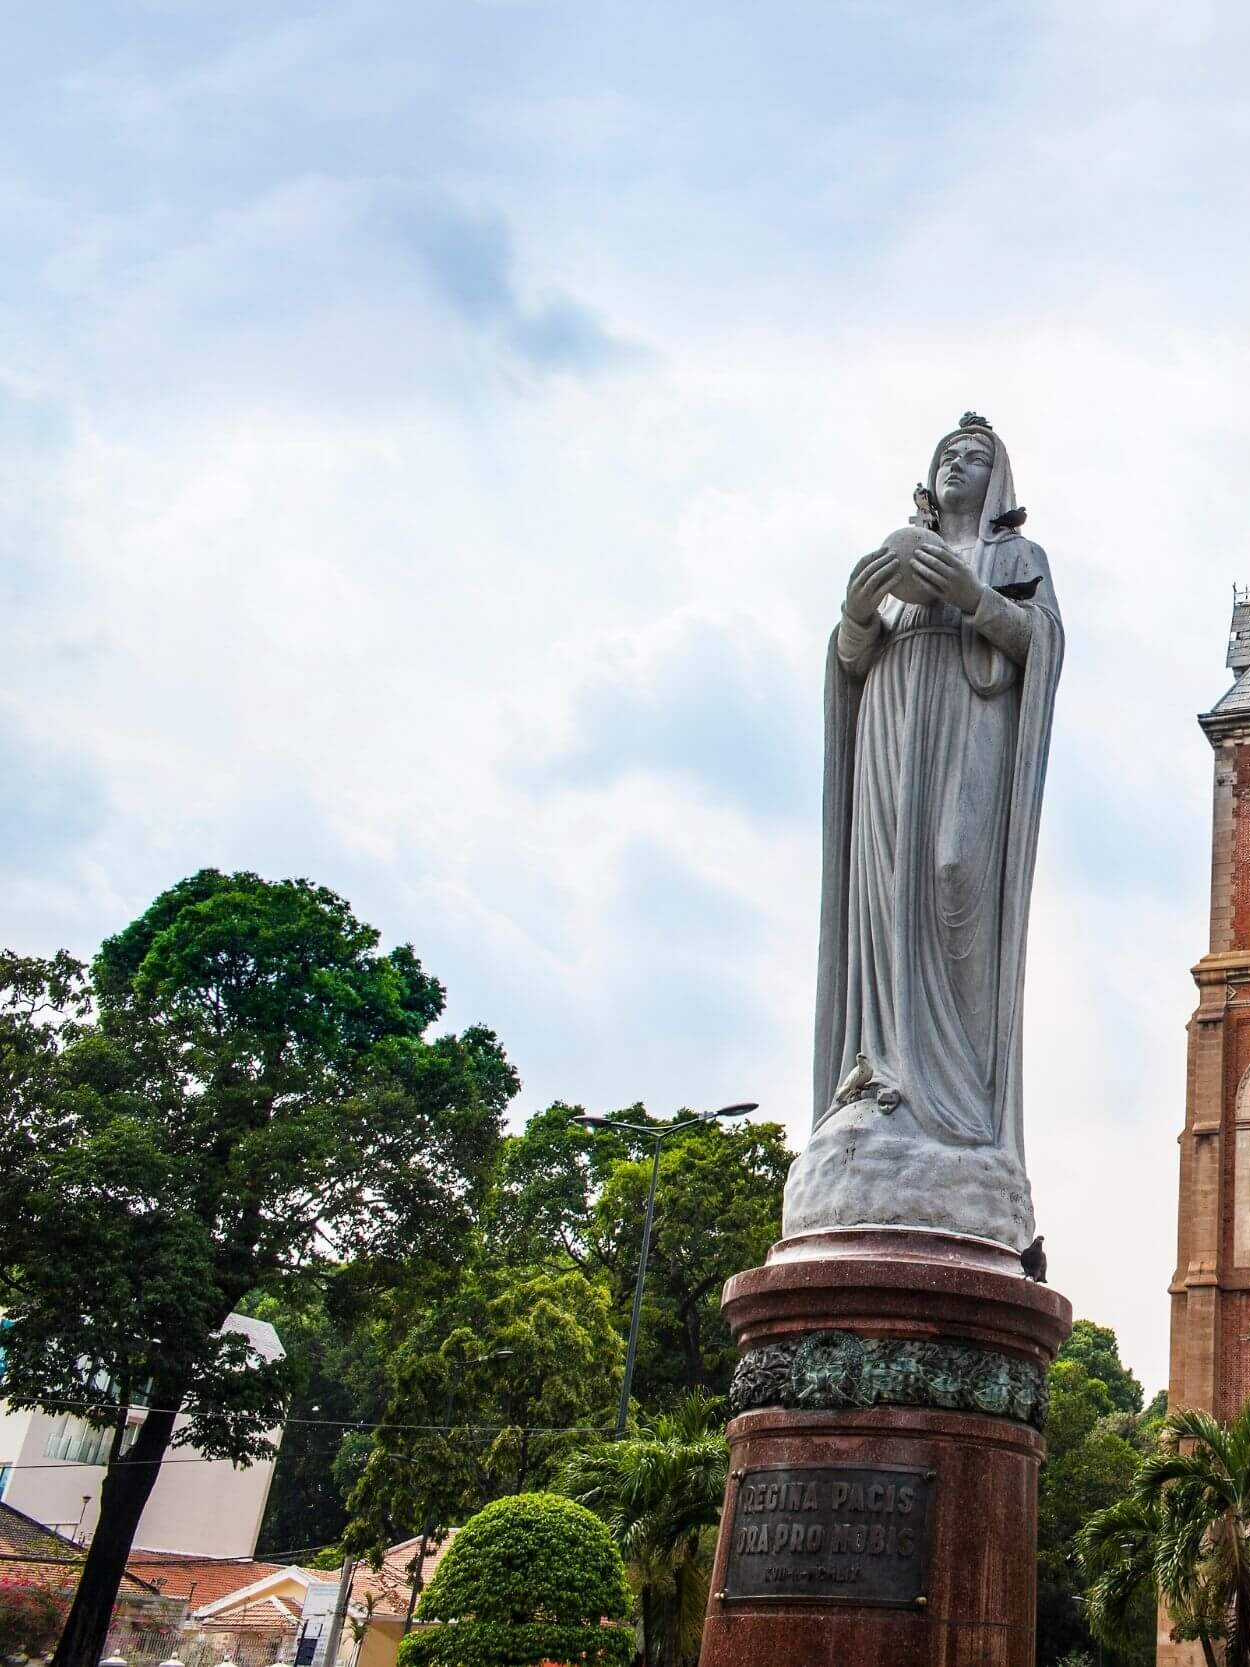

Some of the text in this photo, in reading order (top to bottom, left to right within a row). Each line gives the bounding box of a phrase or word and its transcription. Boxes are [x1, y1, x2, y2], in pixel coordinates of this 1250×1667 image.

[743, 1481, 914, 1514] REGINA PACIS
[736, 1523, 915, 1557] ORA PRO NOBIS
